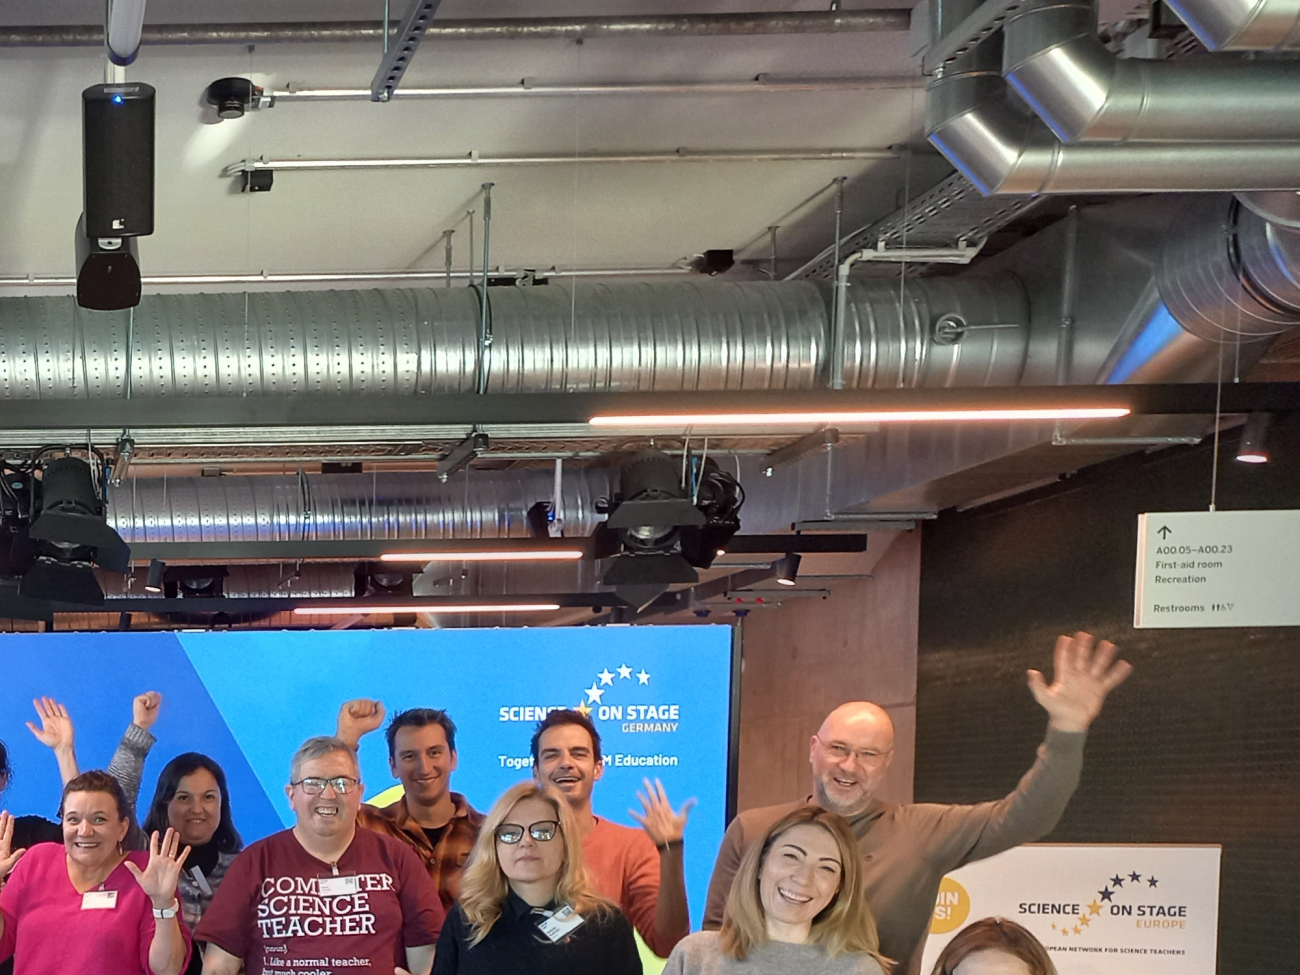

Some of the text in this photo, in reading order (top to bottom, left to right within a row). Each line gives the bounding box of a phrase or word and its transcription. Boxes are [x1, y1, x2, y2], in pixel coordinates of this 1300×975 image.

[1155, 560, 1195, 569] First-aid
[1155, 575, 1206, 584] Recreation
[1153, 604, 1205, 613] Restrooms
[499, 705, 679, 721] SCIEN ON STAGE
[622, 722, 678, 733] GERMANY
[498, 755, 535, 769] Toget
[615, 753, 678, 767] Education
[261, 873, 396, 897] COMTER
[257, 893, 369, 917] SCIENCE
[1018, 903, 1187, 917] SCIENCE ON STAGE
[257, 913, 376, 938] TEACHER
[1136, 919, 1186, 929] EUROPE
[292, 957, 329, 967] normal
[331, 956, 371, 967] teacher,
